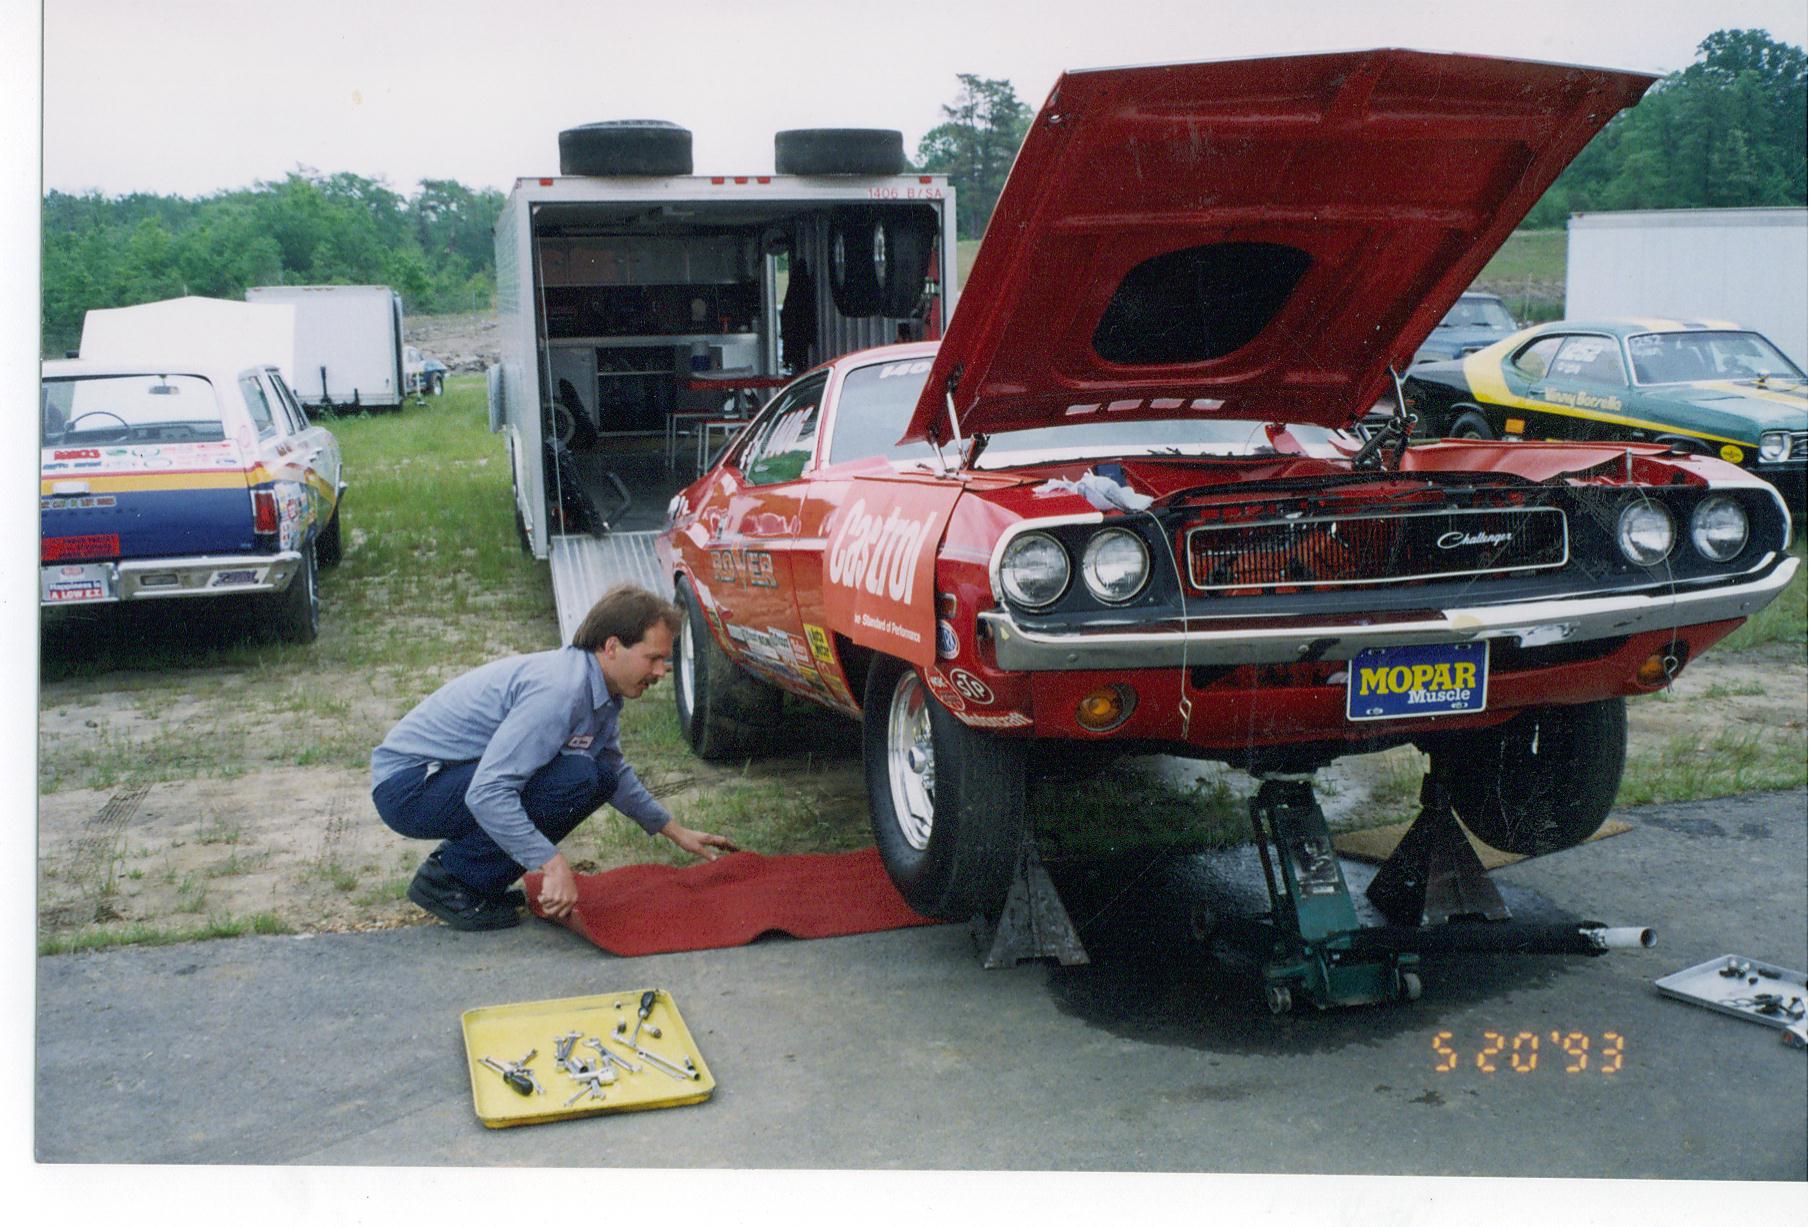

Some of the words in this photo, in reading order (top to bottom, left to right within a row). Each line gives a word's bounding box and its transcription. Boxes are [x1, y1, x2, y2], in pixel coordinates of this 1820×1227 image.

[868, 187, 898, 199] 1406
[907, 187, 942, 199] B/SA
[1437, 531, 1512, 549] Challenger
[830, 498, 938, 605] Castrol
[862, 613, 886, 632] Standard
[956, 674, 985, 699] STP
[1359, 662, 1476, 696] MOPAR
[1408, 688, 1471, 704] Muscle
